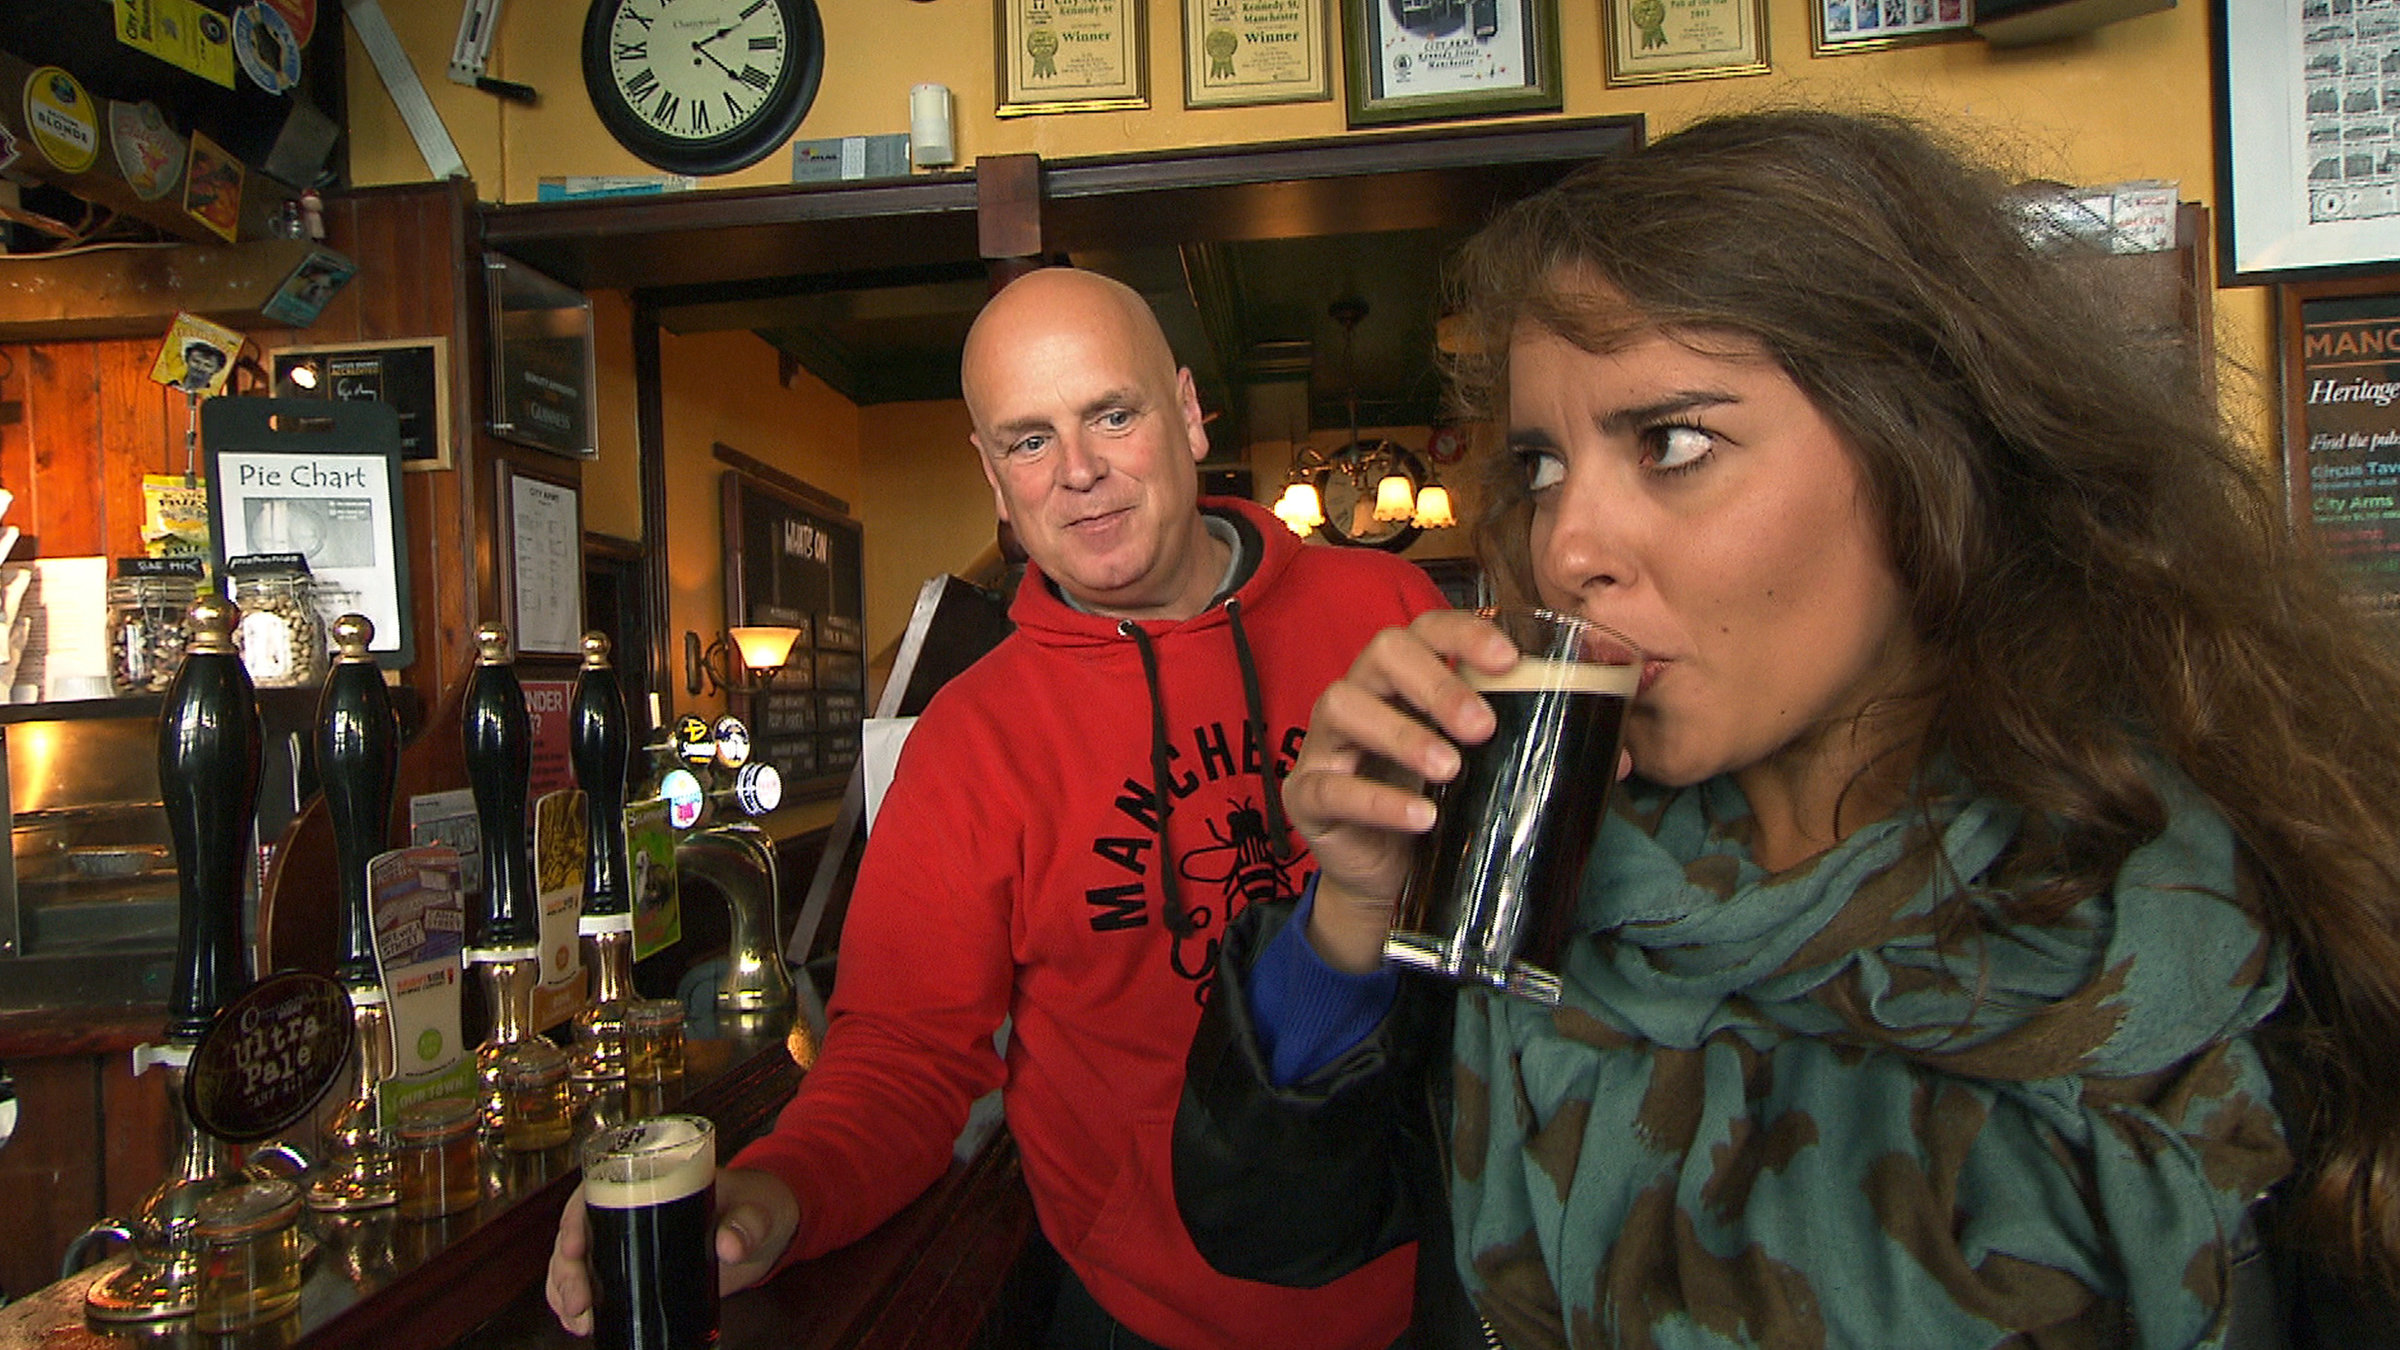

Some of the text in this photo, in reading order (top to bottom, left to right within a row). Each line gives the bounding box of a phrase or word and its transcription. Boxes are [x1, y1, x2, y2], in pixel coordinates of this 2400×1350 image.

[1244, 12, 1299, 24] Manchester
[1062, 31, 1112, 43] Winner
[1245, 31, 1300, 44] Winner
[37, 111, 89, 145] BLONDE
[2308, 376, 2400, 407] Heritage
[2310, 432, 2347, 452] Find
[2348, 431, 2370, 449] the
[240, 462, 366, 488] Pie Chart
[2311, 460, 2400, 480] Circus Tav
[2312, 496, 2395, 514] City Arms
[814, 529, 829, 564] ON
[1085, 719, 1308, 932] MANCHES
[233, 1015, 319, 1070] Ultra
[242, 1045, 312, 1097] Pale
